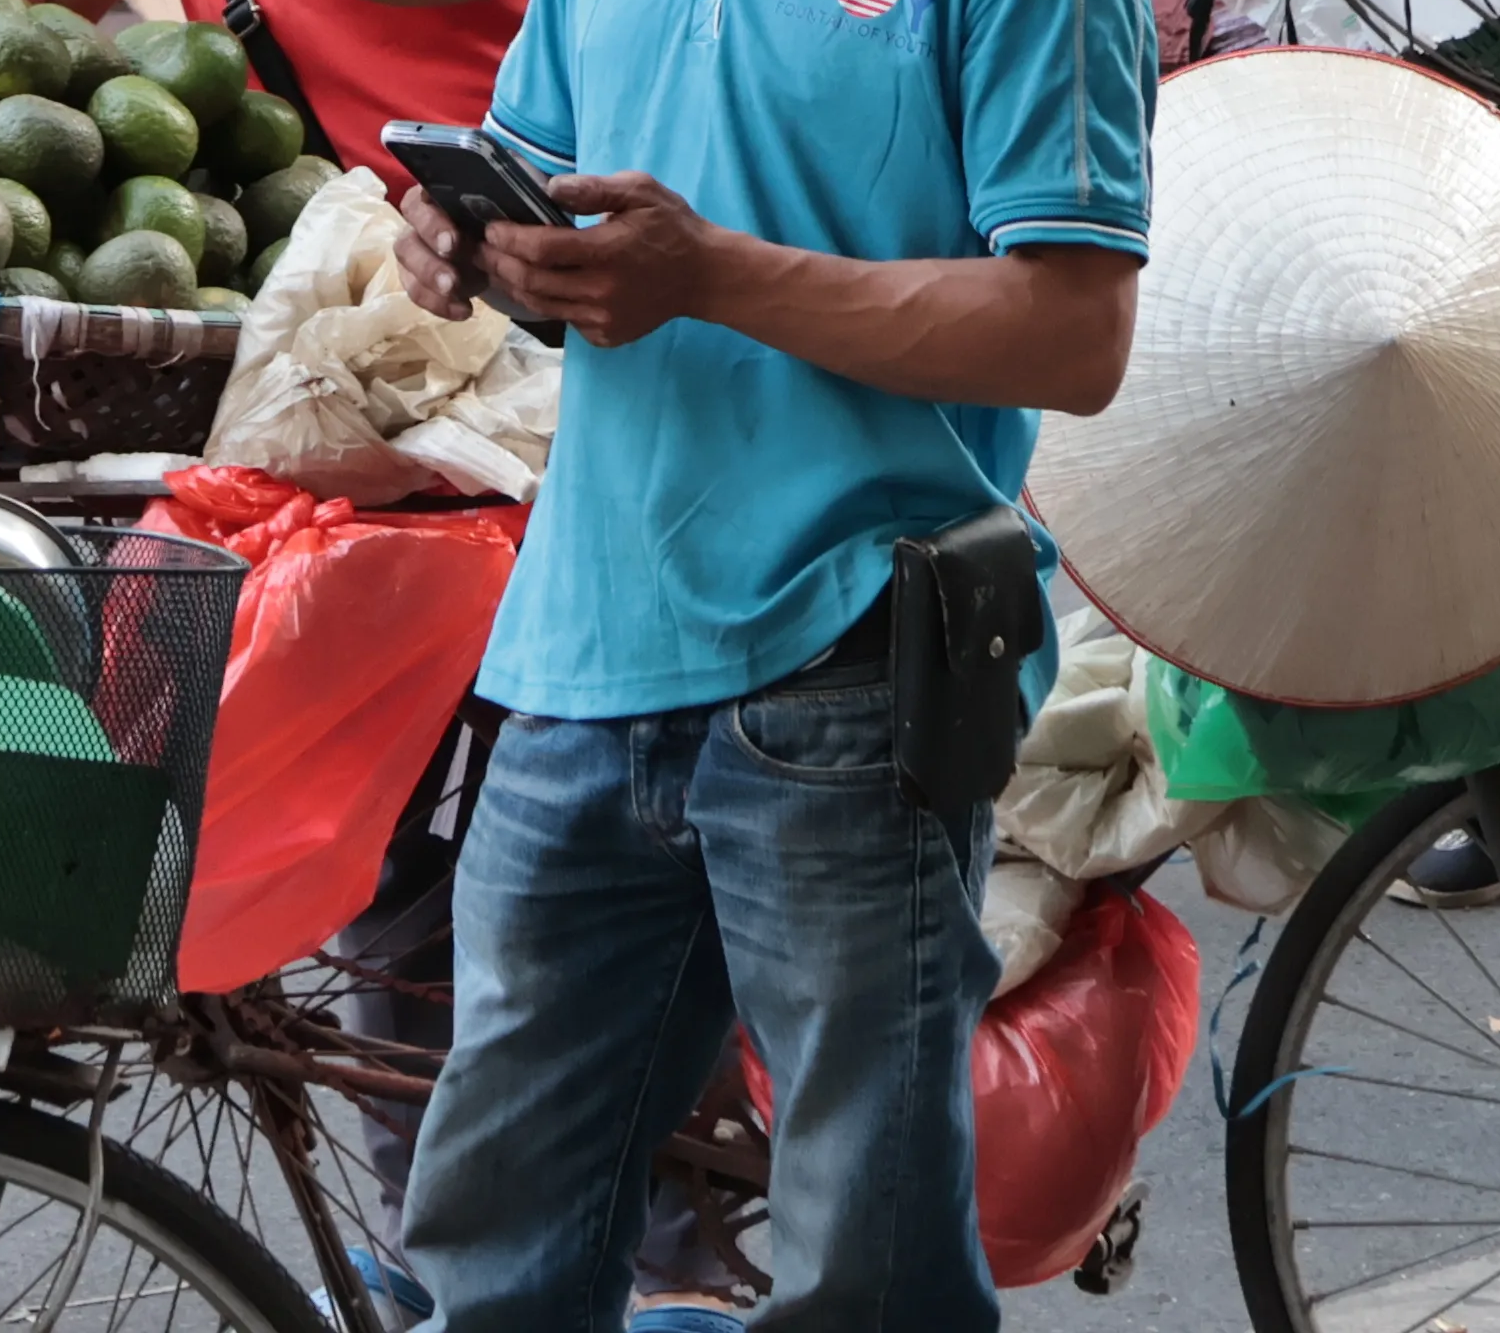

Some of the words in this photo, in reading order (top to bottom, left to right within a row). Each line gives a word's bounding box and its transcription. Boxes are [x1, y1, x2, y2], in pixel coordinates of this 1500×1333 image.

[775, 0, 854, 33] FOUNTAIN
[858, 23, 881, 39] OF
[883, 29, 938, 61] YOUTH
